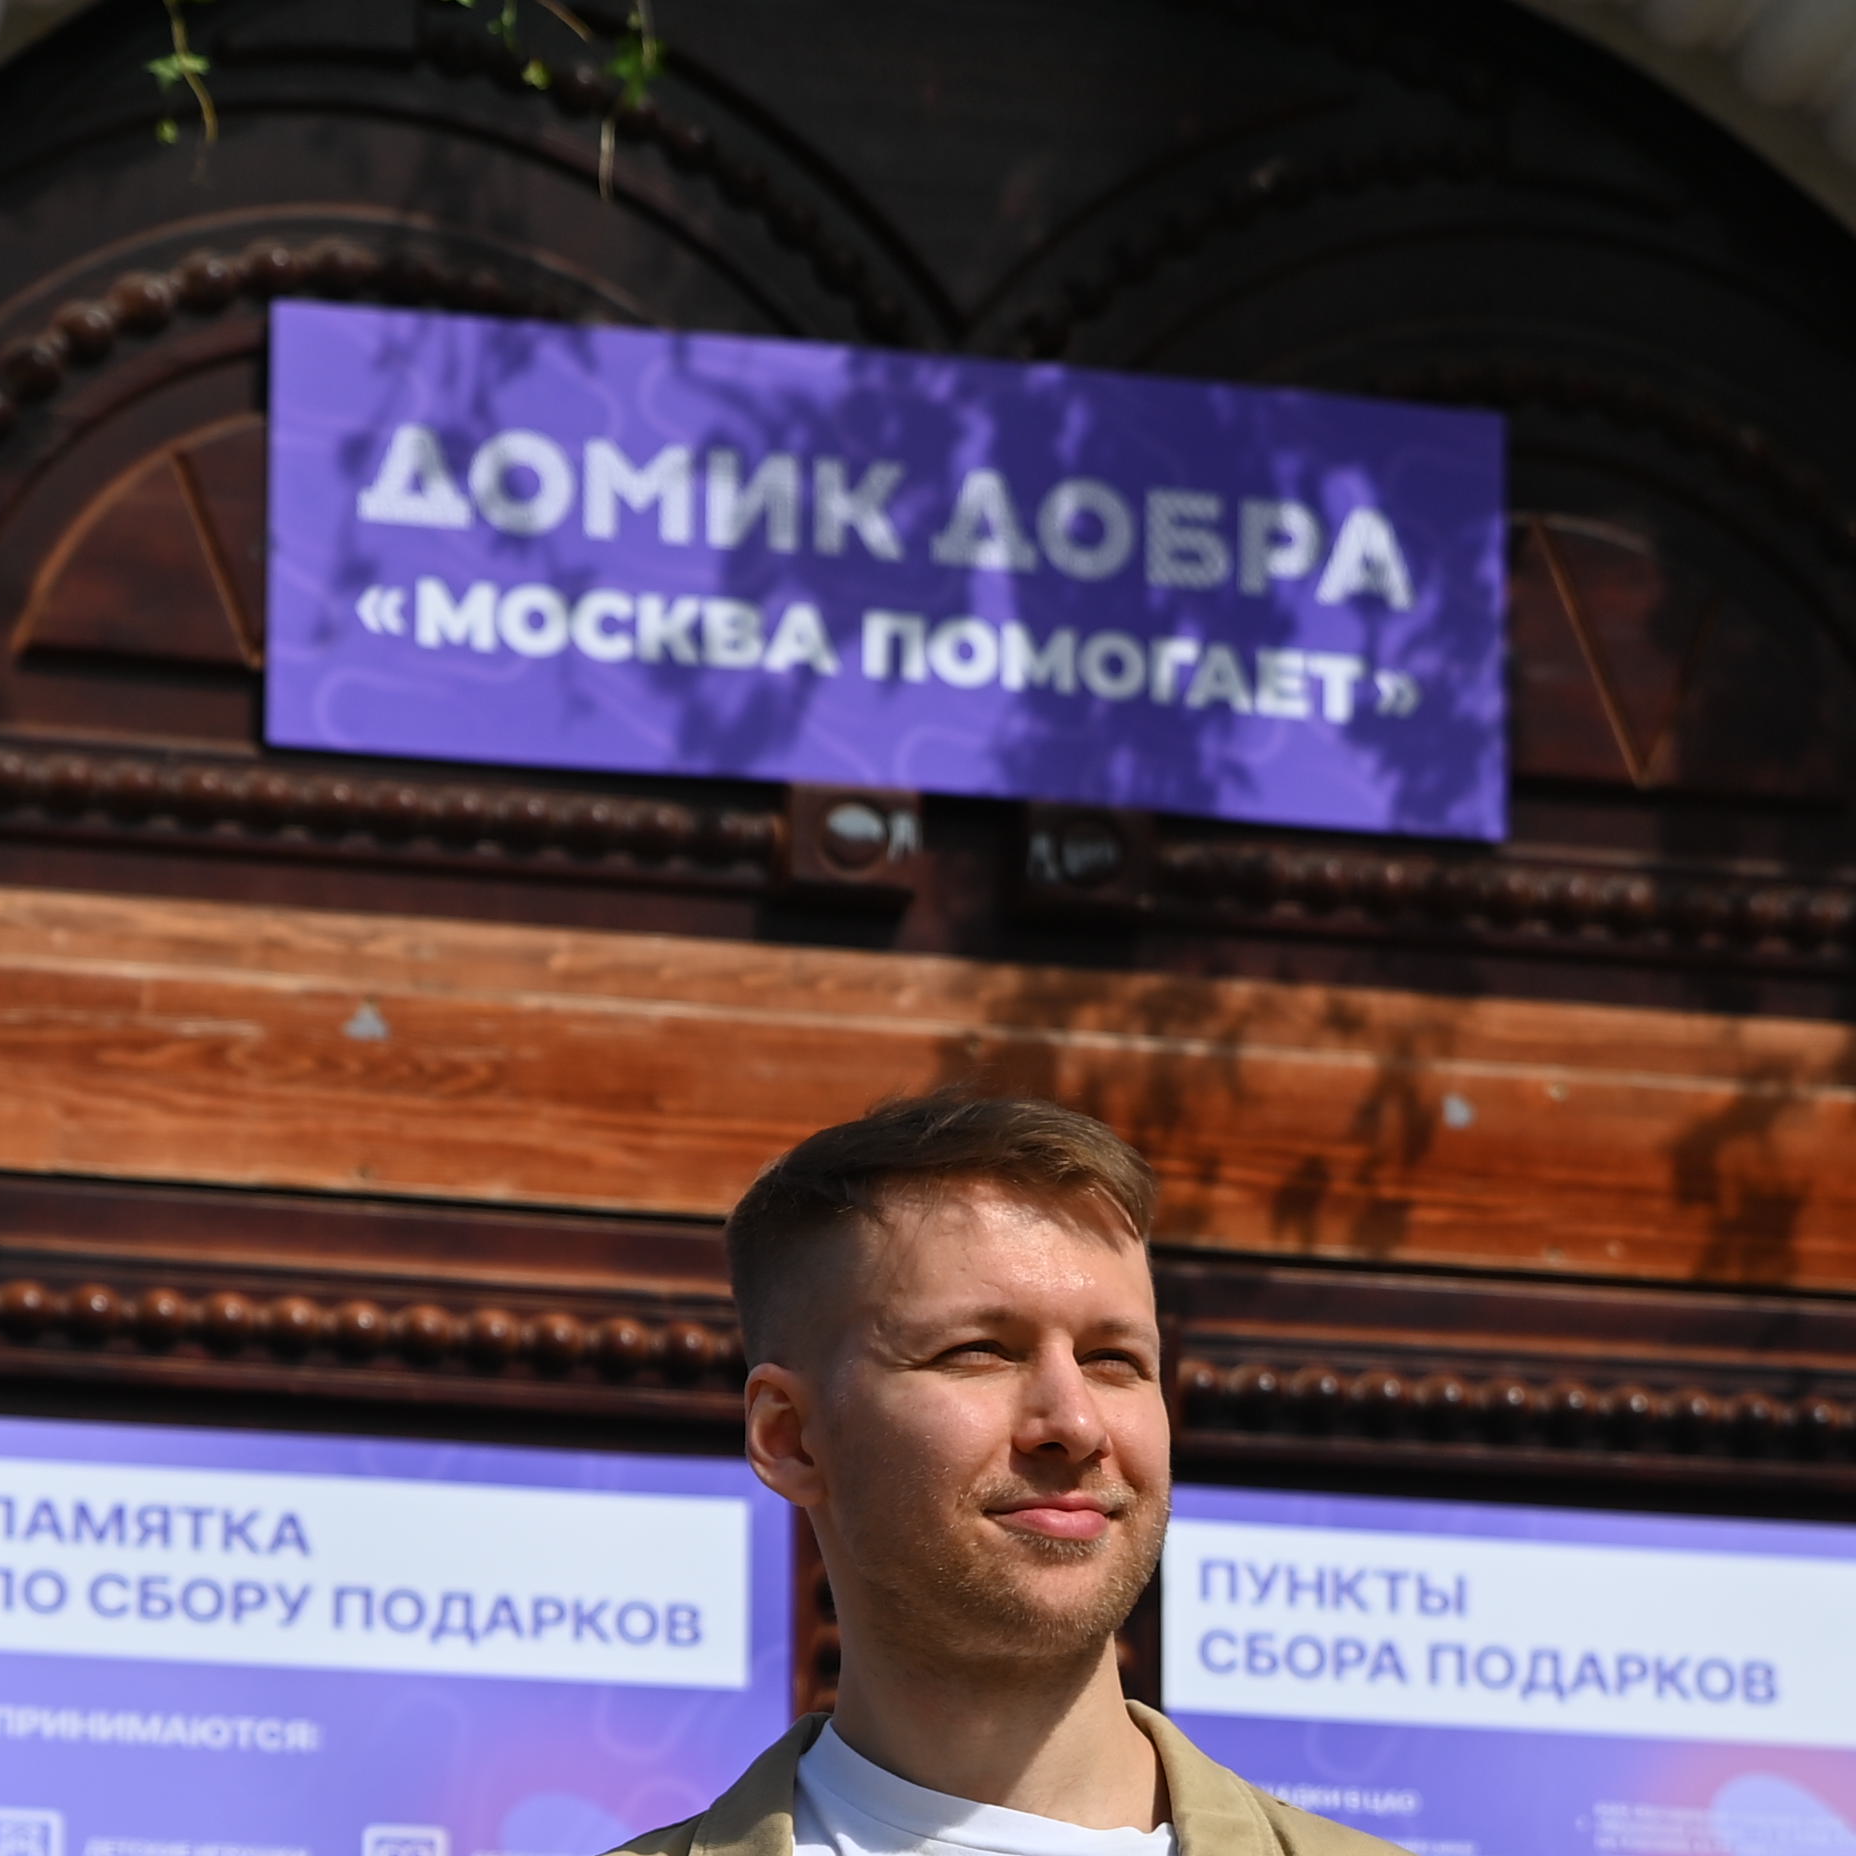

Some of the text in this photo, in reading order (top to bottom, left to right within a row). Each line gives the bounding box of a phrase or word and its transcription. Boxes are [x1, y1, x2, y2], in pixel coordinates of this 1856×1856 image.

[357, 420, 1415, 612] ДОМИК ДОБРА
[356, 575, 1422, 727] «МОСКВА ПОМОГАЕТ»
[86, 1572, 313, 1631] СБОРУ
[330, 1584, 706, 1650] ПОДАРКОВ
[1197, 1558, 1470, 1618] ПУНКТЫ
[1197, 1628, 1781, 1706] СБОРА ПОДАРКОВ
